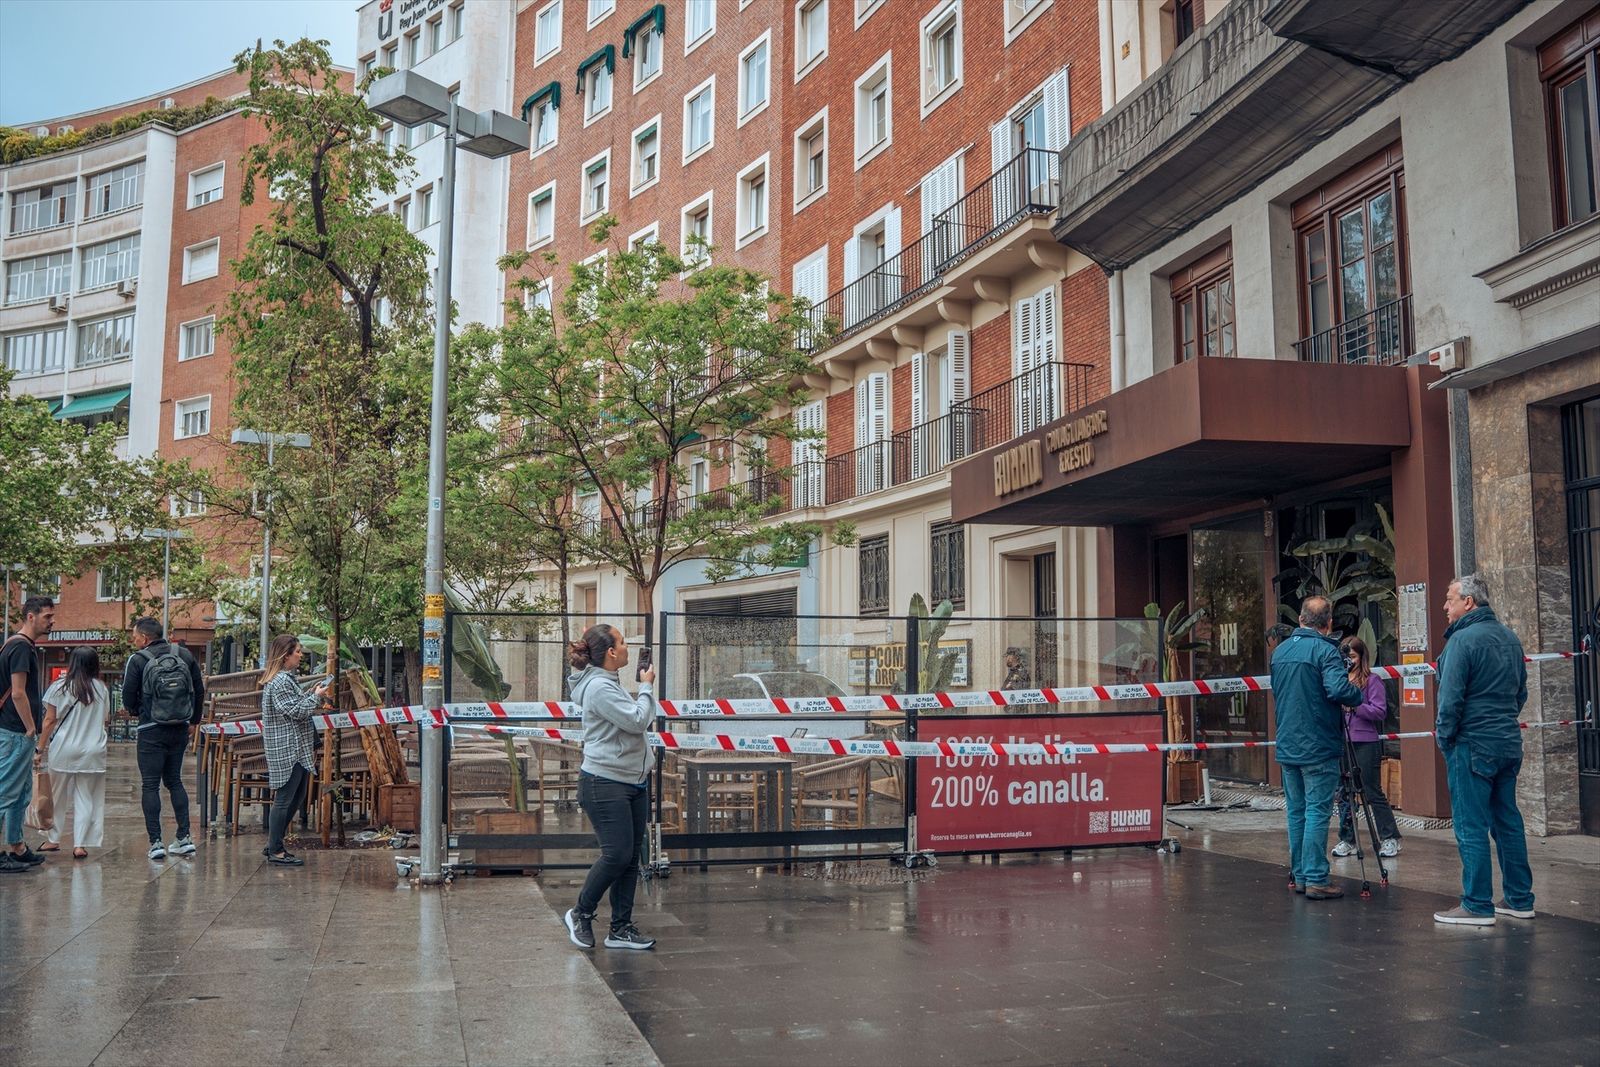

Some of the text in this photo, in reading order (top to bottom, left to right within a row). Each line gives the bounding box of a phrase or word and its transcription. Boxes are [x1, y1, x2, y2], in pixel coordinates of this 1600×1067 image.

[61, 631, 85, 640] PARRILLA
[876, 647, 904, 668] COM
[875, 668, 895, 685] ORO
[931, 734, 1082, 768] 100% Italia.
[931, 772, 1109, 808] 200% canalla.
[1111, 809, 1151, 827] BURRO
[975, 831, 1032, 840] www.burrocanaglia.es
